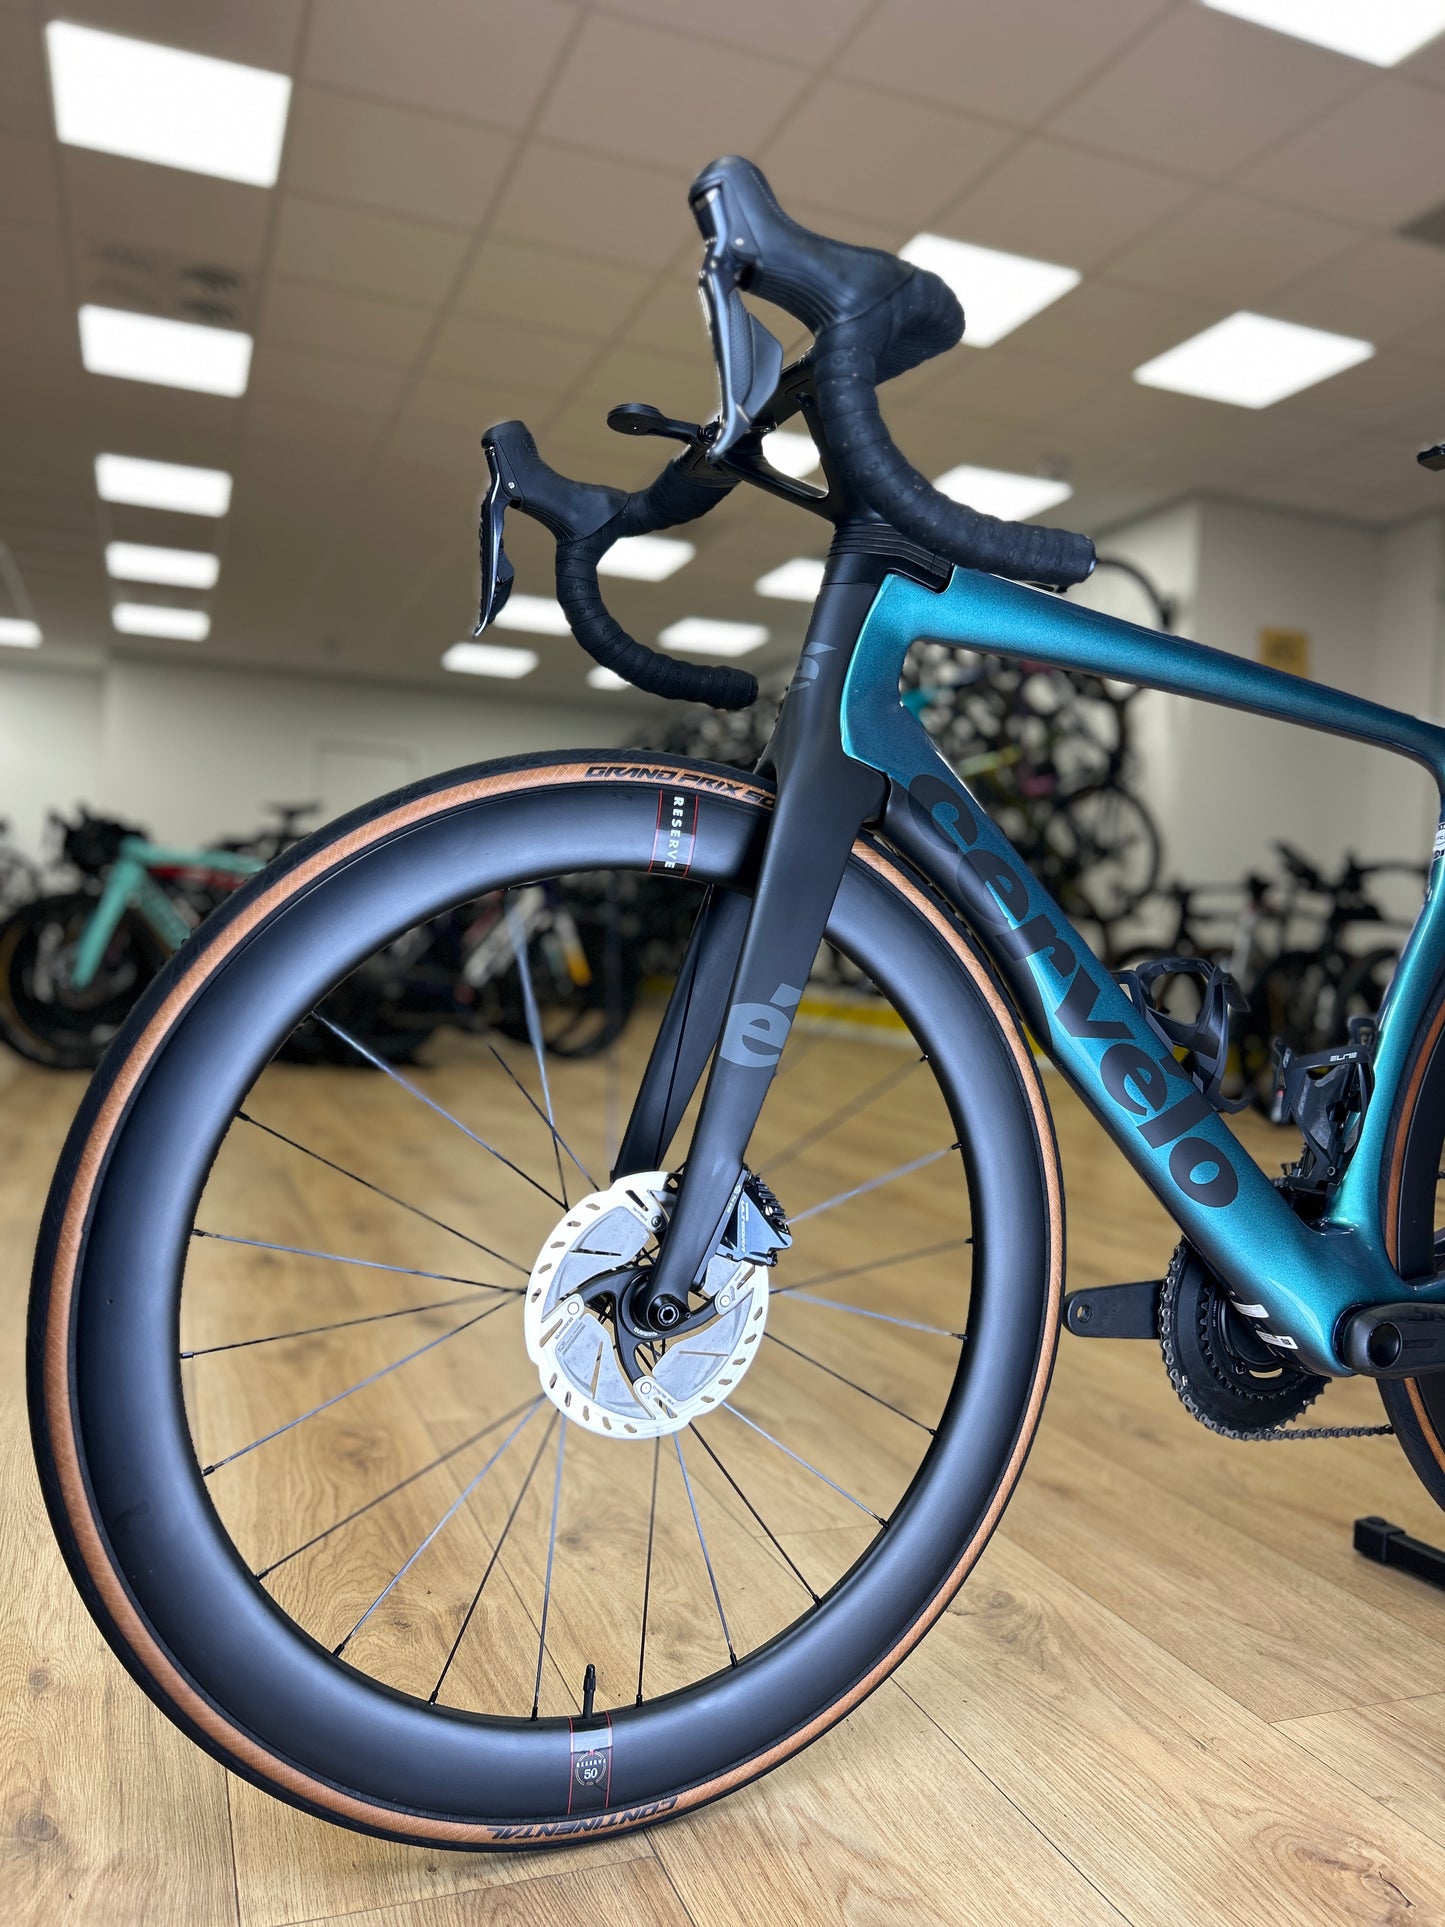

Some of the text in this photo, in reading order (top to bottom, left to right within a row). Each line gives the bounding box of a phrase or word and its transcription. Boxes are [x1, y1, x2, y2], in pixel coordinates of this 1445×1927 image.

[585, 766, 677, 781] GRAND
[678, 773, 743, 796] PRIX
[664, 796, 685, 869] RESERVE
[908, 774, 1239, 1208] cervélo
[576, 1758, 606, 1768] RESERVE
[583, 1767, 599, 1781] 50
[486, 1796, 679, 1840] CONTINENTAL
